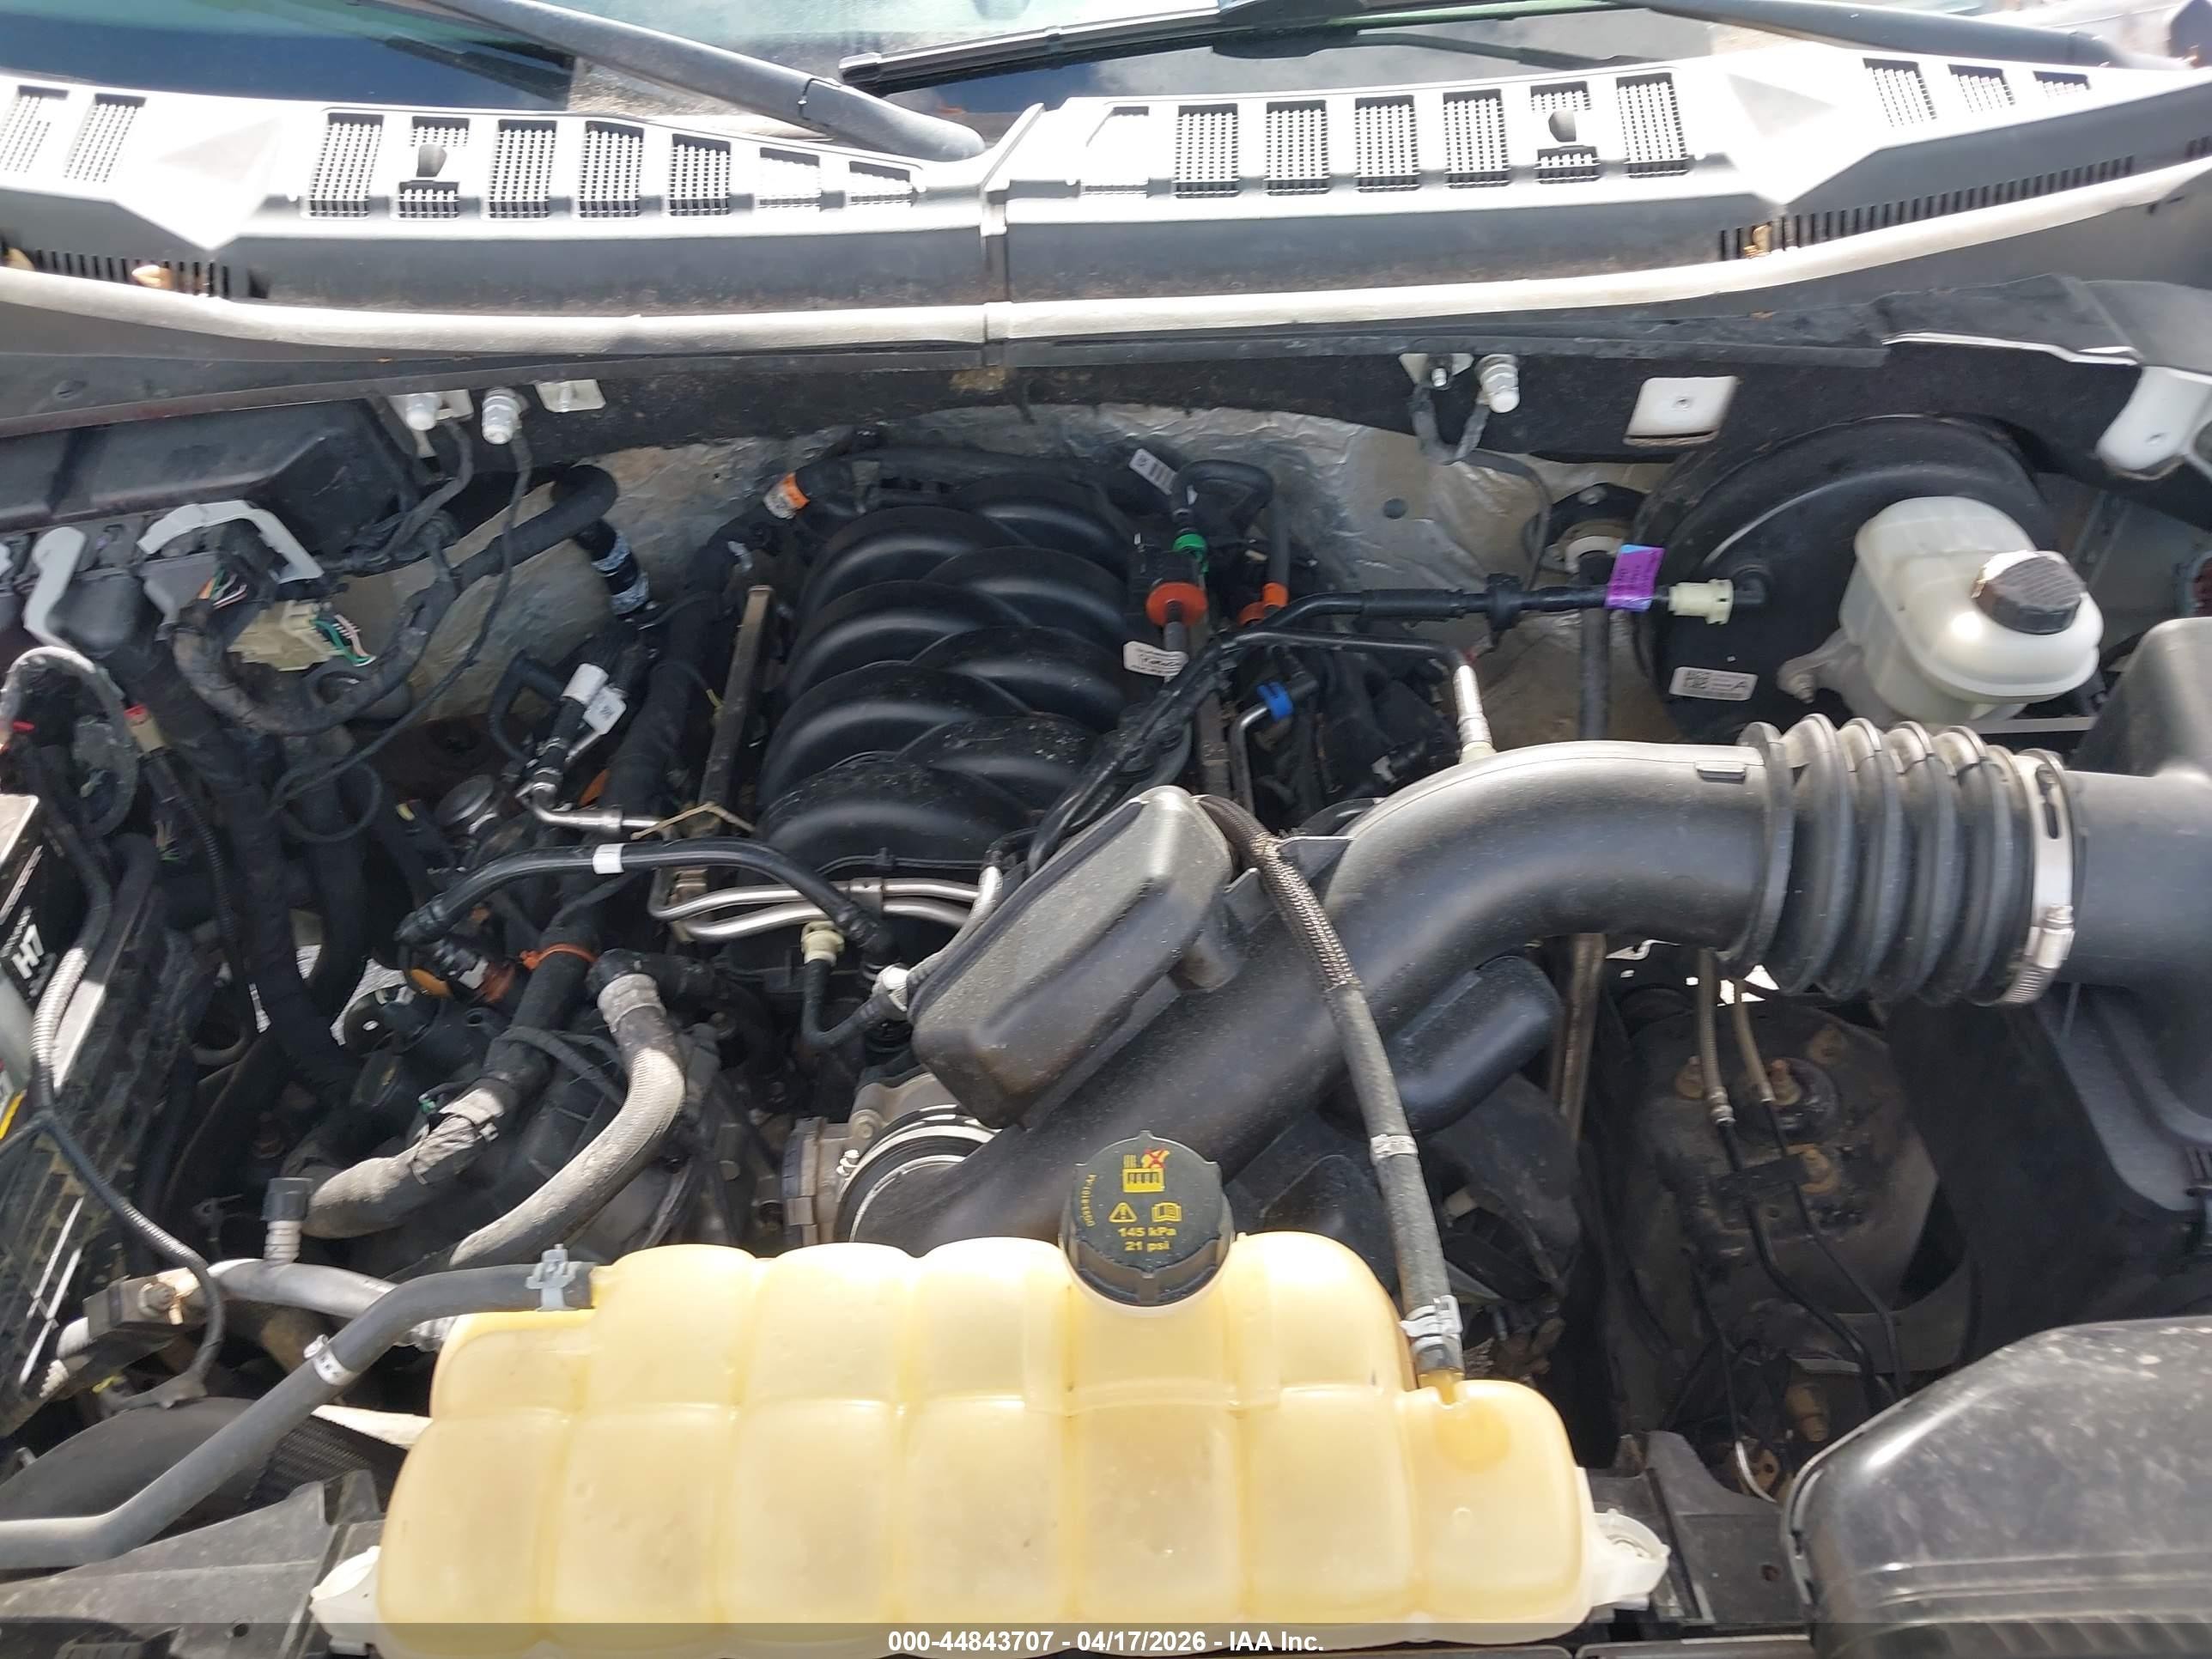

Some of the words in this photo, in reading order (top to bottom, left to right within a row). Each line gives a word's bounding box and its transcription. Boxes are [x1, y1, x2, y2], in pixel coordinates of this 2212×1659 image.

[11, 923, 45, 980] H7
[1118, 1227, 1146, 1237] 145
[1148, 1226, 1176, 1237] kPa
[1125, 1241, 1143, 1251] 21
[1147, 1240, 1170, 1253] psi
